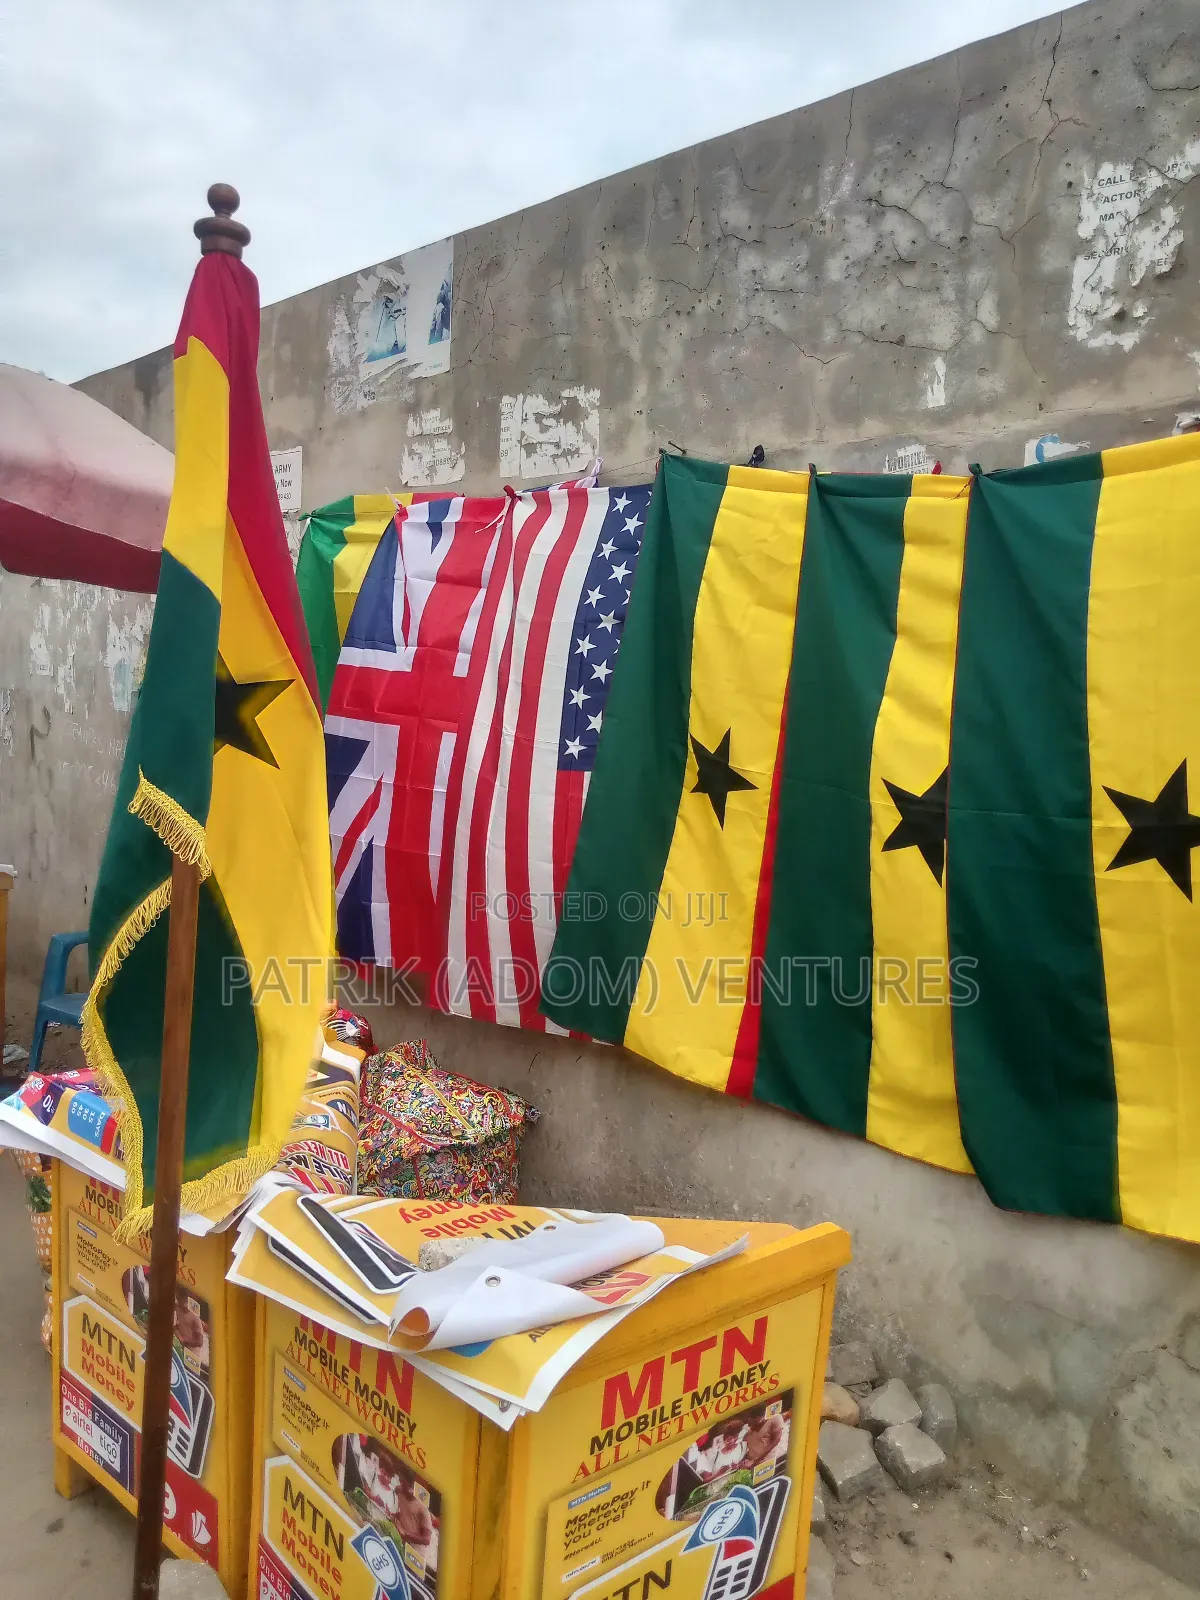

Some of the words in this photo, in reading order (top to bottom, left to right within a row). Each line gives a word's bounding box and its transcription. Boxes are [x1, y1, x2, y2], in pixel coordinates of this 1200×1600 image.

[1098, 174, 1126, 188] CALL
[275, 464, 292, 474] ARMY
[420, 1206, 517, 1239] Mobile
[82, 1312, 135, 1374] MTN
[82, 1338, 135, 1394] Mobile
[82, 1356, 134, 1411] Money
[294, 1326, 350, 1386] MOBILE
[354, 1376, 417, 1439] MONEY
[601, 1315, 769, 1430] MTN
[61, 1383, 77, 1404] One
[79, 1398, 93, 1420] Big
[94, 1411, 123, 1446] Family
[72, 1412, 94, 1438] airtel
[285, 1340, 317, 1378] ALL
[320, 1369, 427, 1470] NETWORKS
[589, 1396, 684, 1456] MOBILE
[690, 1360, 771, 1410] MONEY
[571, 1442, 630, 1484] ALL
[636, 1371, 780, 1453] NETWORKS
[77, 1435, 104, 1467] Money
[283, 1476, 344, 1562] MTN
[564, 1497, 636, 1538] wherever
[565, 1487, 638, 1530] MoMoPay
[711, 1507, 735, 1536] GHS
[282, 1507, 343, 1587] Mobile
[563, 1529, 592, 1551] you
[259, 1555, 275, 1583] One
[371, 1553, 390, 1572] GHS
[604, 1559, 673, 1600] TN
